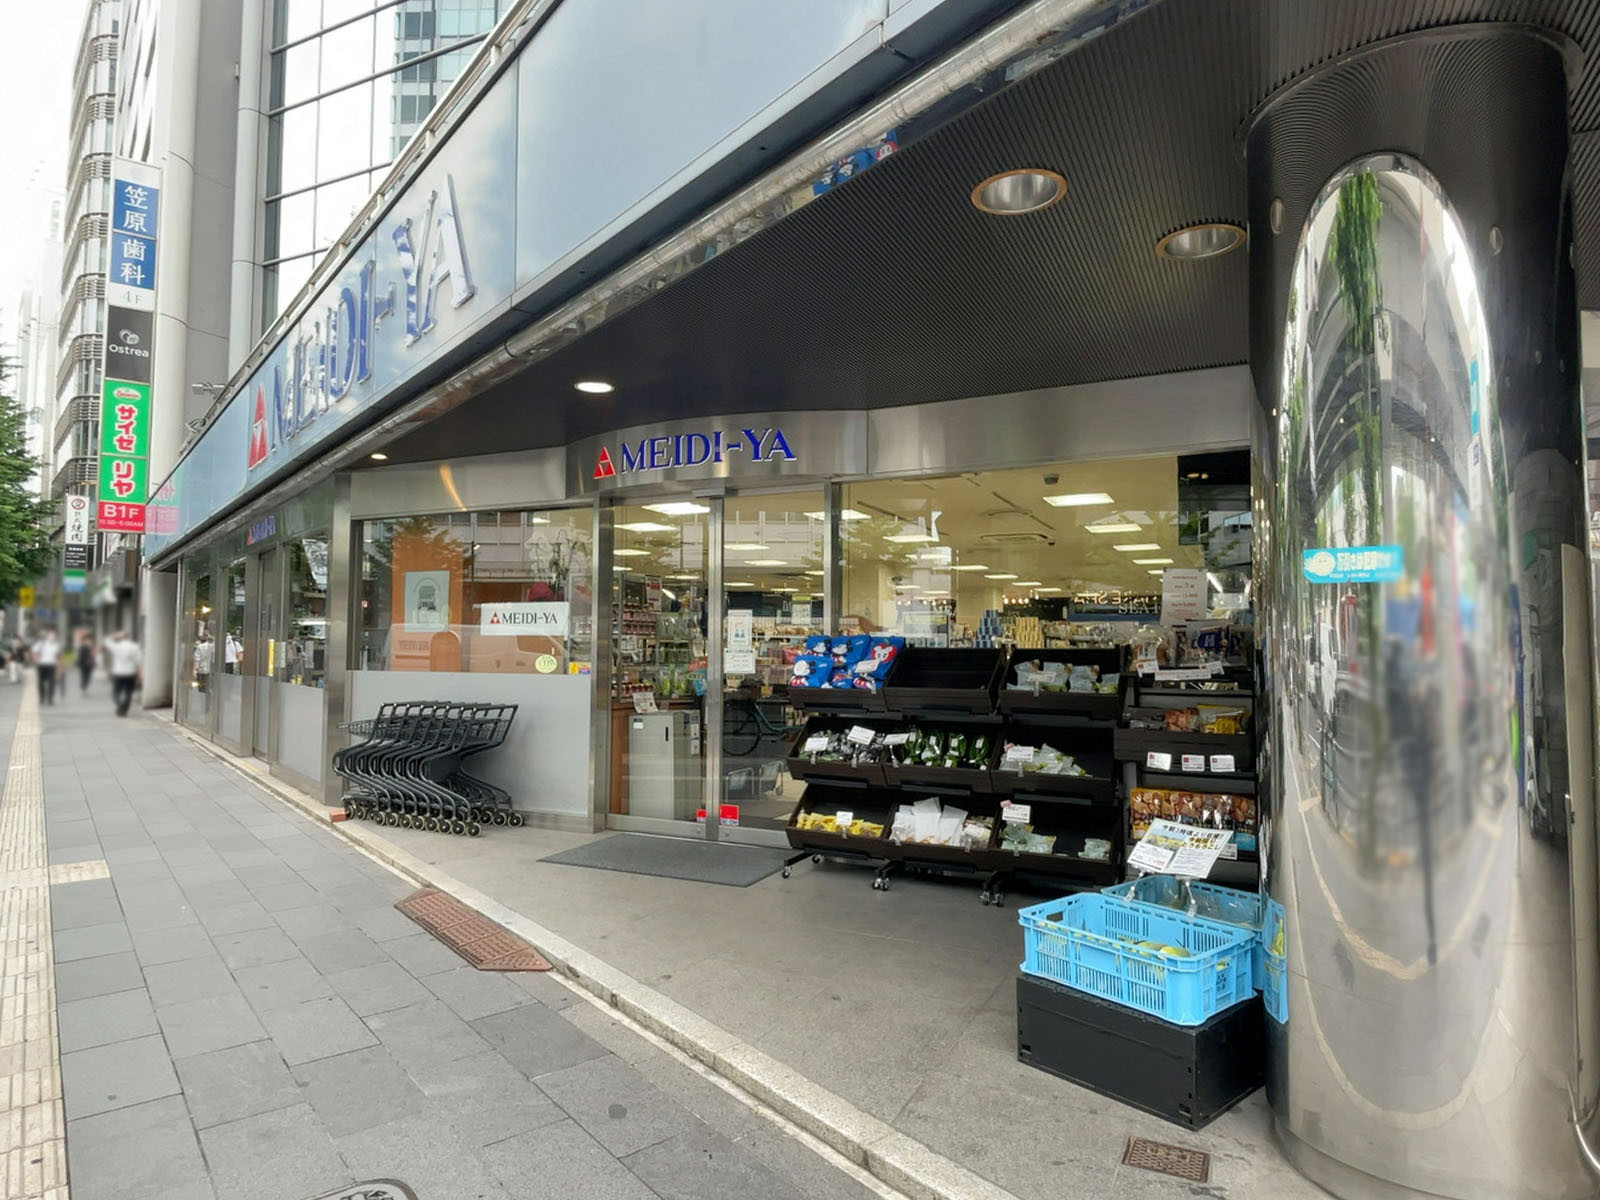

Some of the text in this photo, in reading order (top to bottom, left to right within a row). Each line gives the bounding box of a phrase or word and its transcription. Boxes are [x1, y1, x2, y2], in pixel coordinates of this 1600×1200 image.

[120, 185, 149, 286] 笠原歯科
[272, 172, 476, 452] MEIDI-YA
[109, 343, 149, 358] Ostrea
[111, 404, 137, 497] サイゼリヤ
[621, 428, 797, 474] MEIDI-YA
[103, 504, 139, 519] B1F
[502, 612, 558, 625] MEIDI-YA
